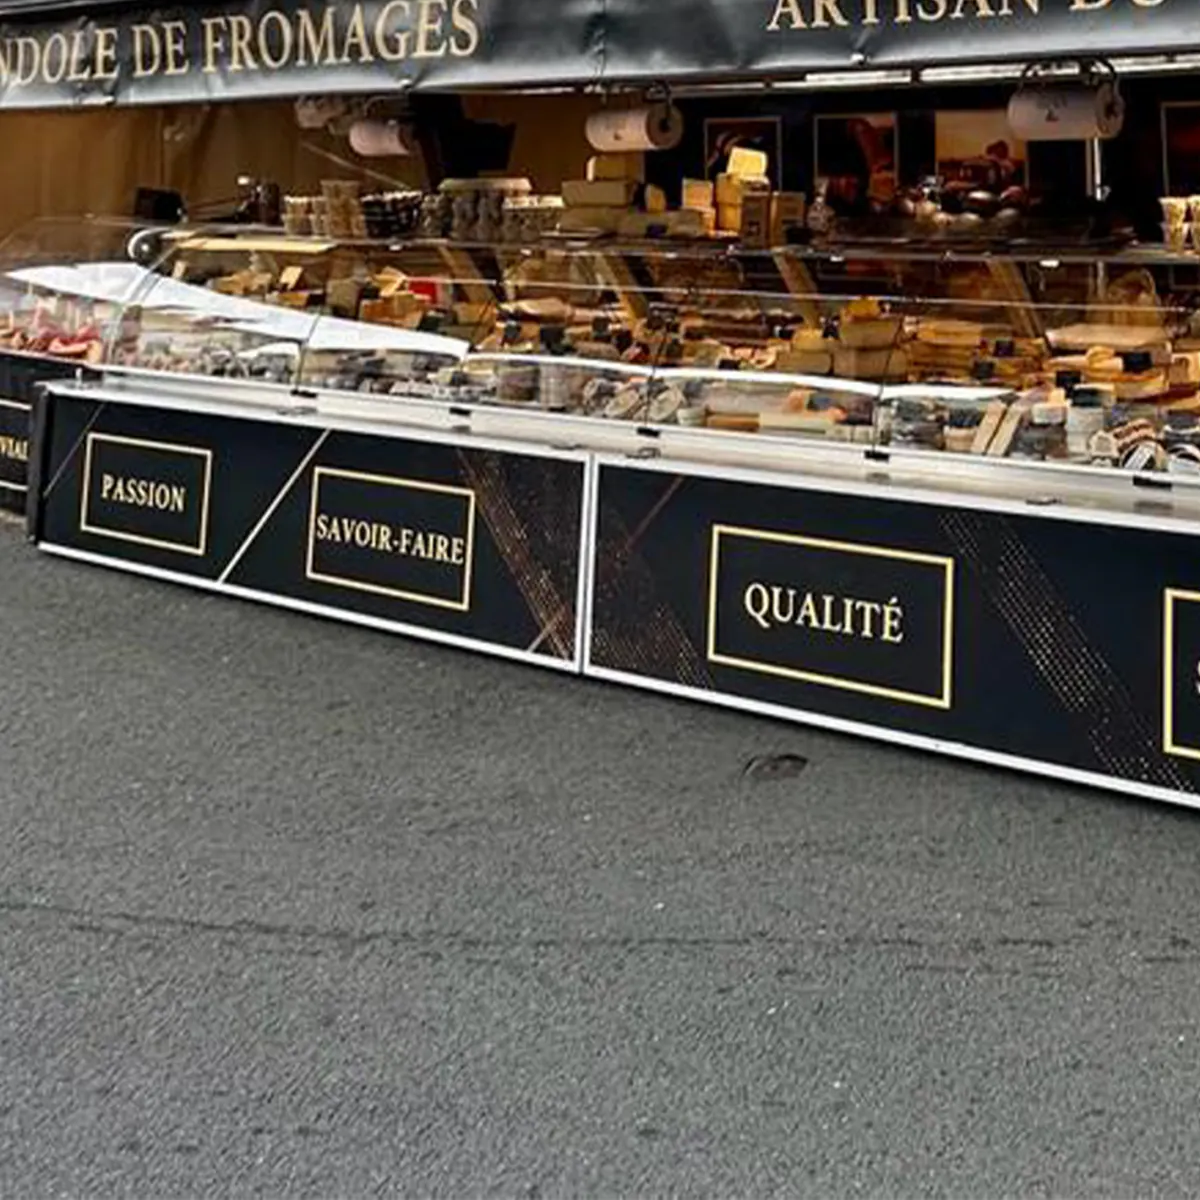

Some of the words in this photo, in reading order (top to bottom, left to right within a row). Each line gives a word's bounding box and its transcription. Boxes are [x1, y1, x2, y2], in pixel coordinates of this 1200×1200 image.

[131, 21, 190, 78] DE
[101, 474, 186, 514] PASSION
[316, 512, 465, 565] SAVOIR-FAIRE
[743, 582, 904, 643] QUALITÉ
